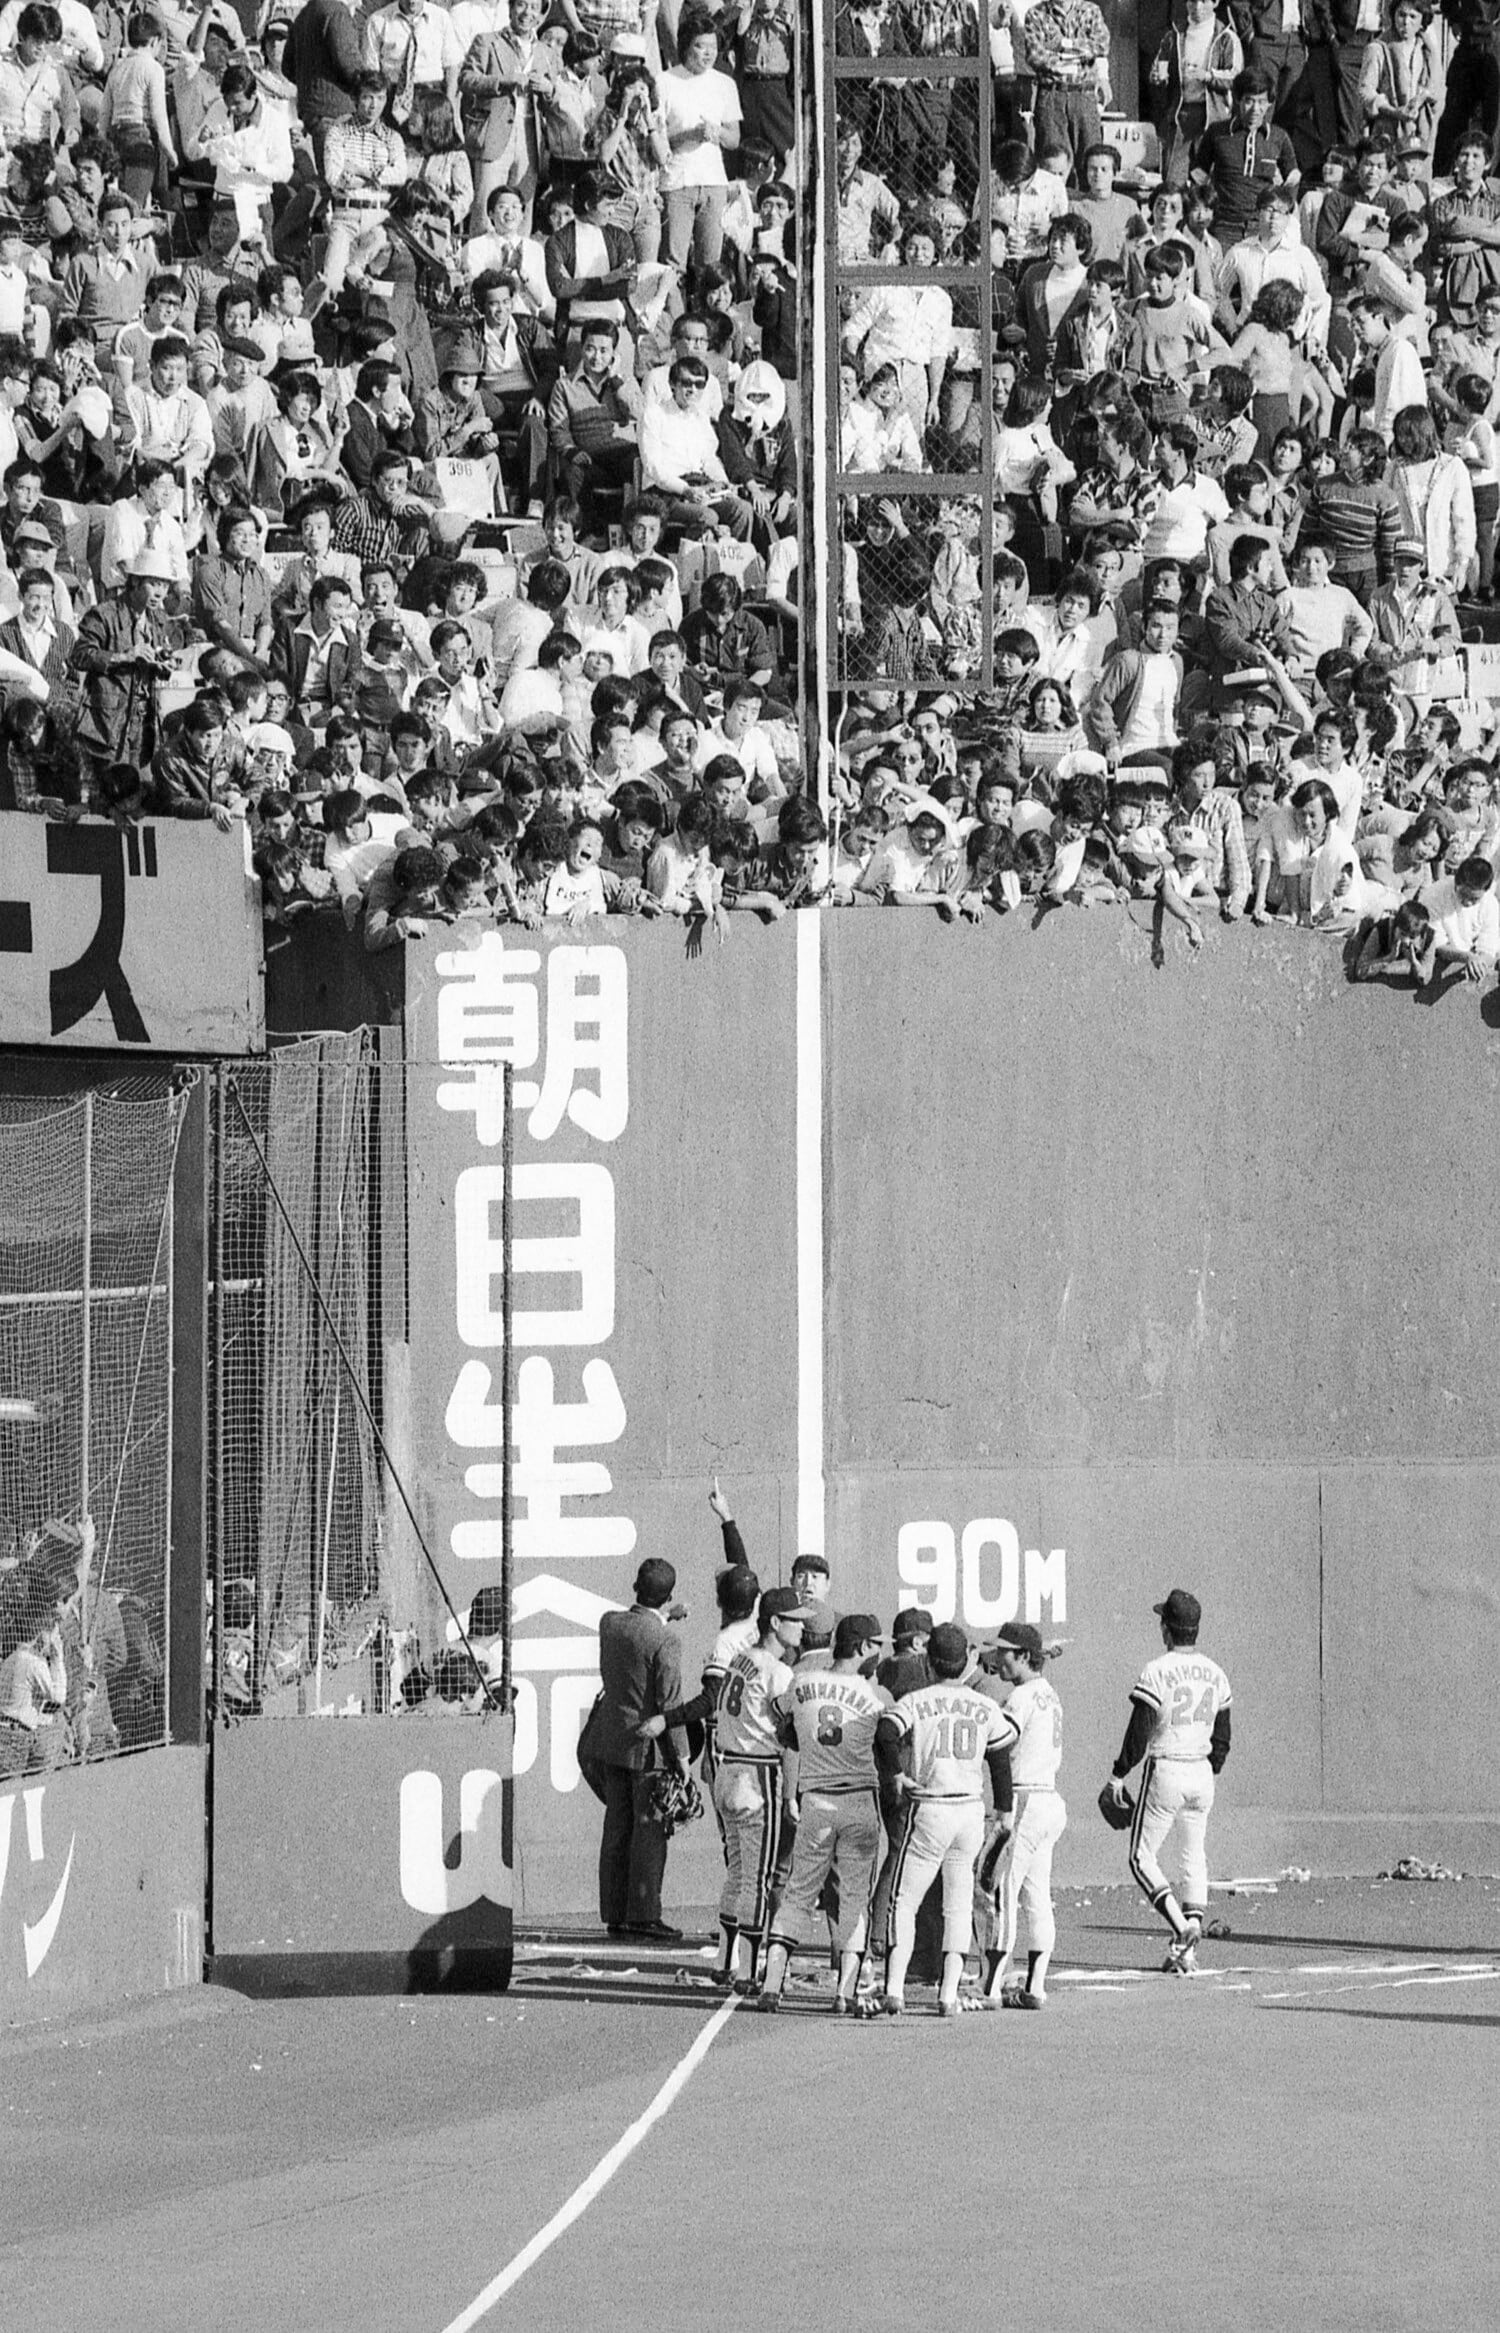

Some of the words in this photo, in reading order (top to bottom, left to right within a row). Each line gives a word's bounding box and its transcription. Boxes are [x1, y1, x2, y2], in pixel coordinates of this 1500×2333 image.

[448, 461, 473, 476] 396
[817, 1704, 843, 1746] 8
[1171, 1686, 1216, 1726] 24
[935, 1717, 978, 1760] 10
